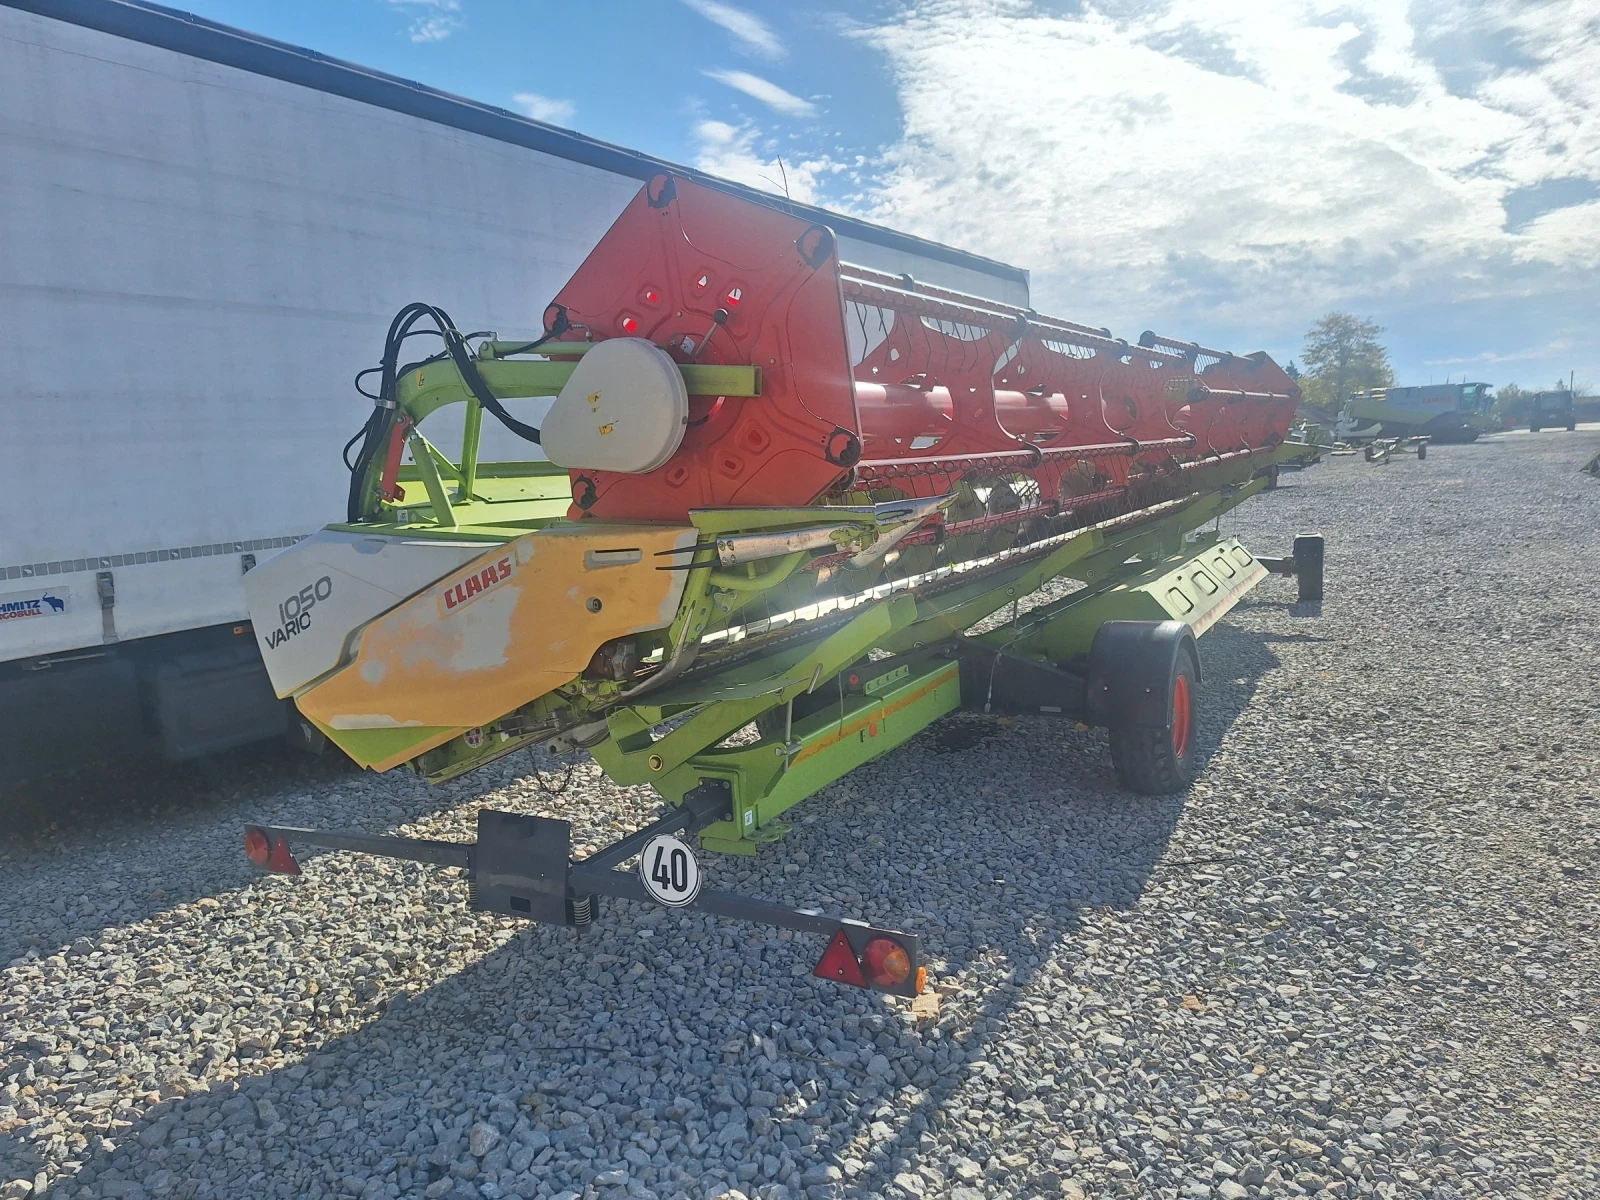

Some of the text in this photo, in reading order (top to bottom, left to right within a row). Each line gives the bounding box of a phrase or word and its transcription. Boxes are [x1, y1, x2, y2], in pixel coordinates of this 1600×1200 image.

[279, 576, 332, 625] 1050
[444, 557, 512, 609] CLAAS
[265, 612, 311, 650] VARIO
[652, 846, 688, 893] 40
